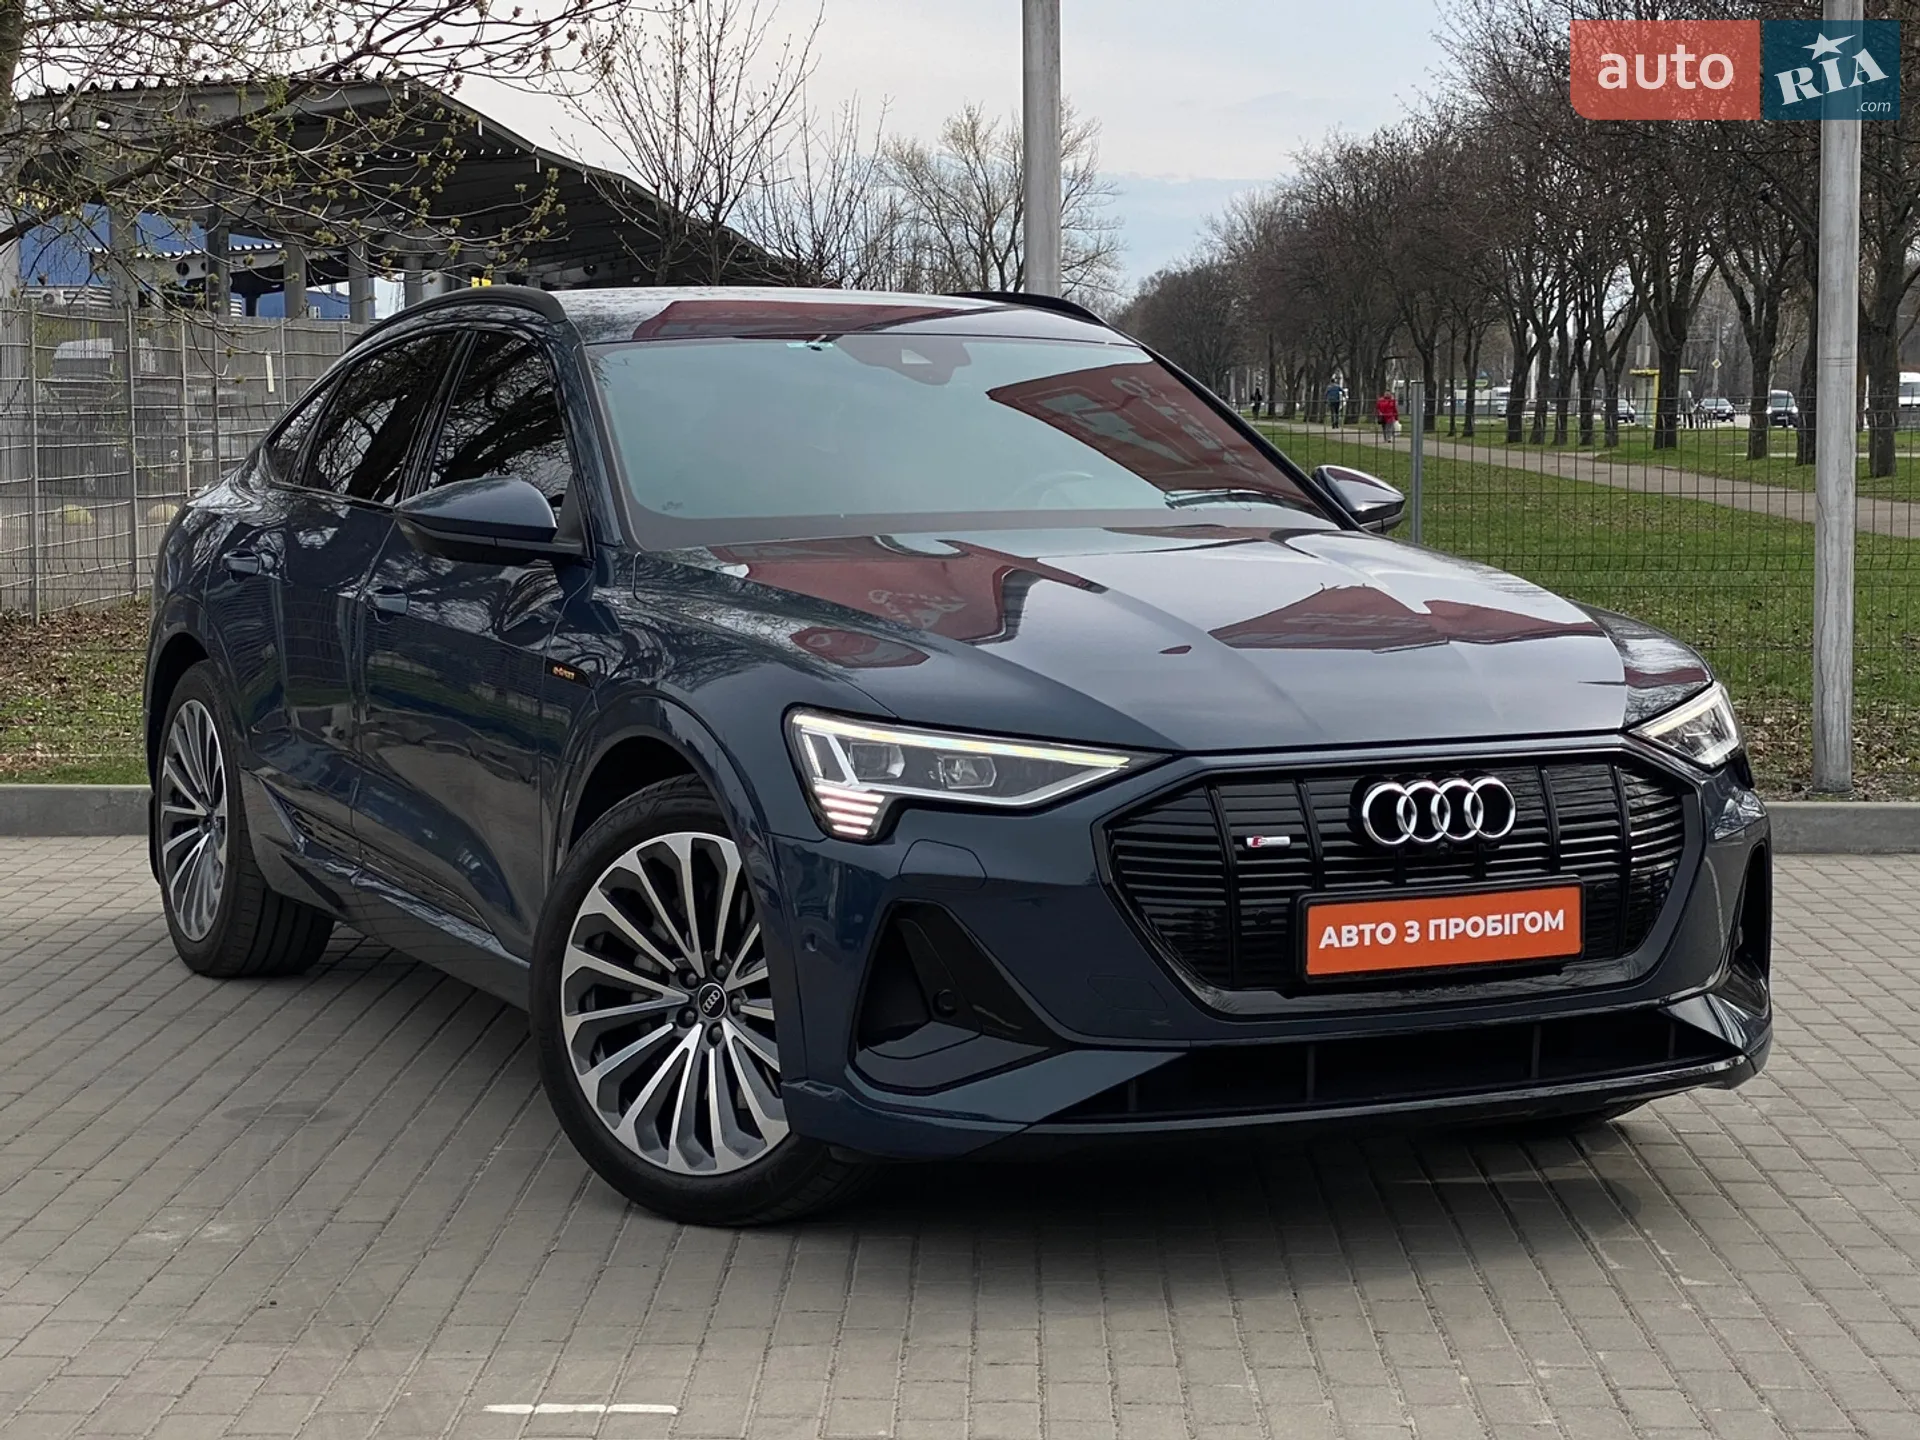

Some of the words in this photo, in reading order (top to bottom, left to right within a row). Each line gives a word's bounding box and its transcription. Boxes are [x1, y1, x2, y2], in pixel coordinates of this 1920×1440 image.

[1318, 922, 1397, 949] АВТО
[1403, 920, 1421, 944] З
[1428, 909, 1565, 941] ПРОБІГОМ
